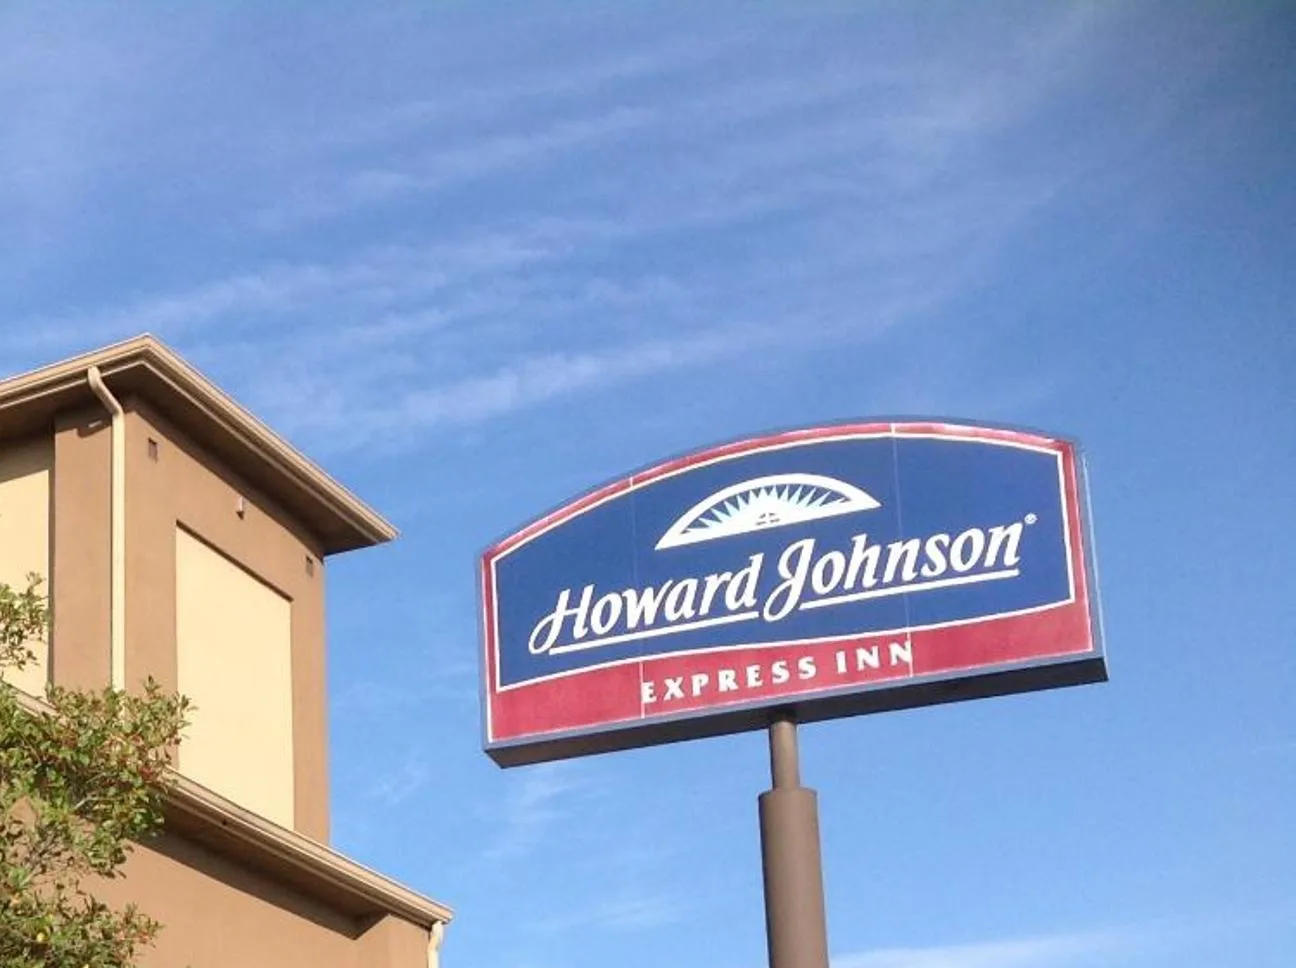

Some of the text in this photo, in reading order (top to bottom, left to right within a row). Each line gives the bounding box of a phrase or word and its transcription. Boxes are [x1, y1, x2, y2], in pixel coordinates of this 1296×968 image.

[528, 523, 1023, 655] Howard Johnson
[641, 640, 914, 704] EXPRESS INN
